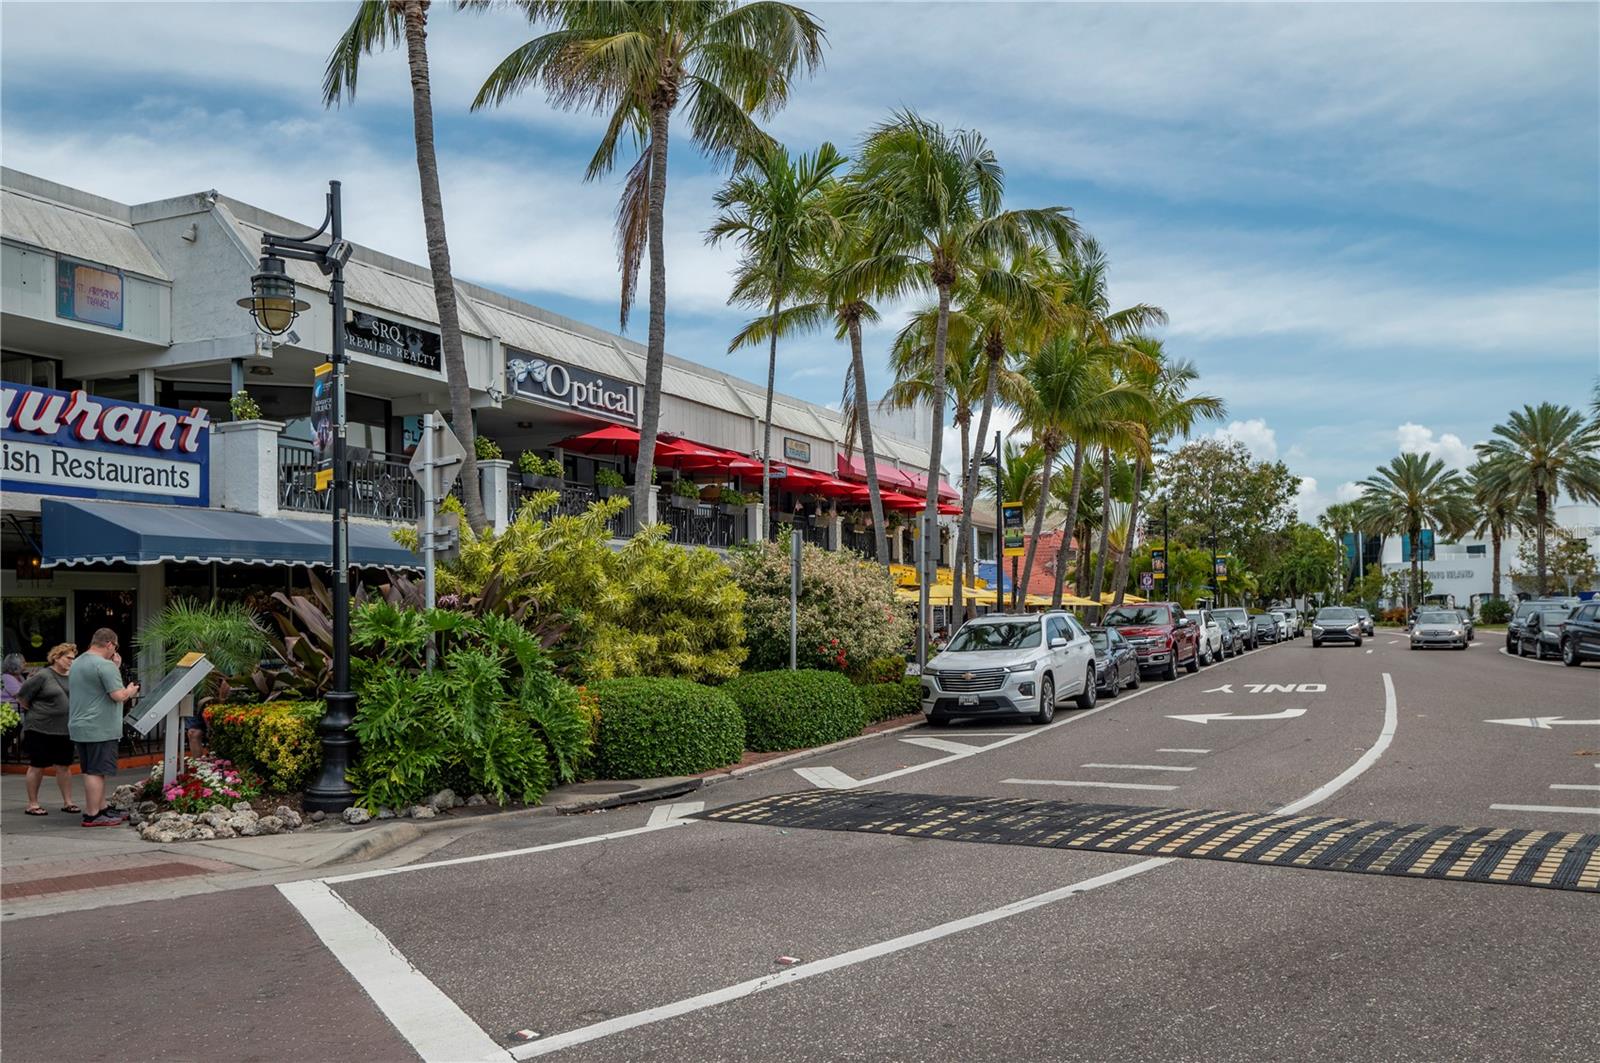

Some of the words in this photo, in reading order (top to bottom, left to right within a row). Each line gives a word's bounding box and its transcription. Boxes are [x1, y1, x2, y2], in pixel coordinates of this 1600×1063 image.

[87, 295, 111, 310] TRAVEL
[371, 321, 404, 346] SRQ
[397, 347, 436, 366] REALTY
[546, 364, 635, 416] Optical
[51, 449, 190, 489] Restaurants
[1200, 683, 1327, 693] ONLY
